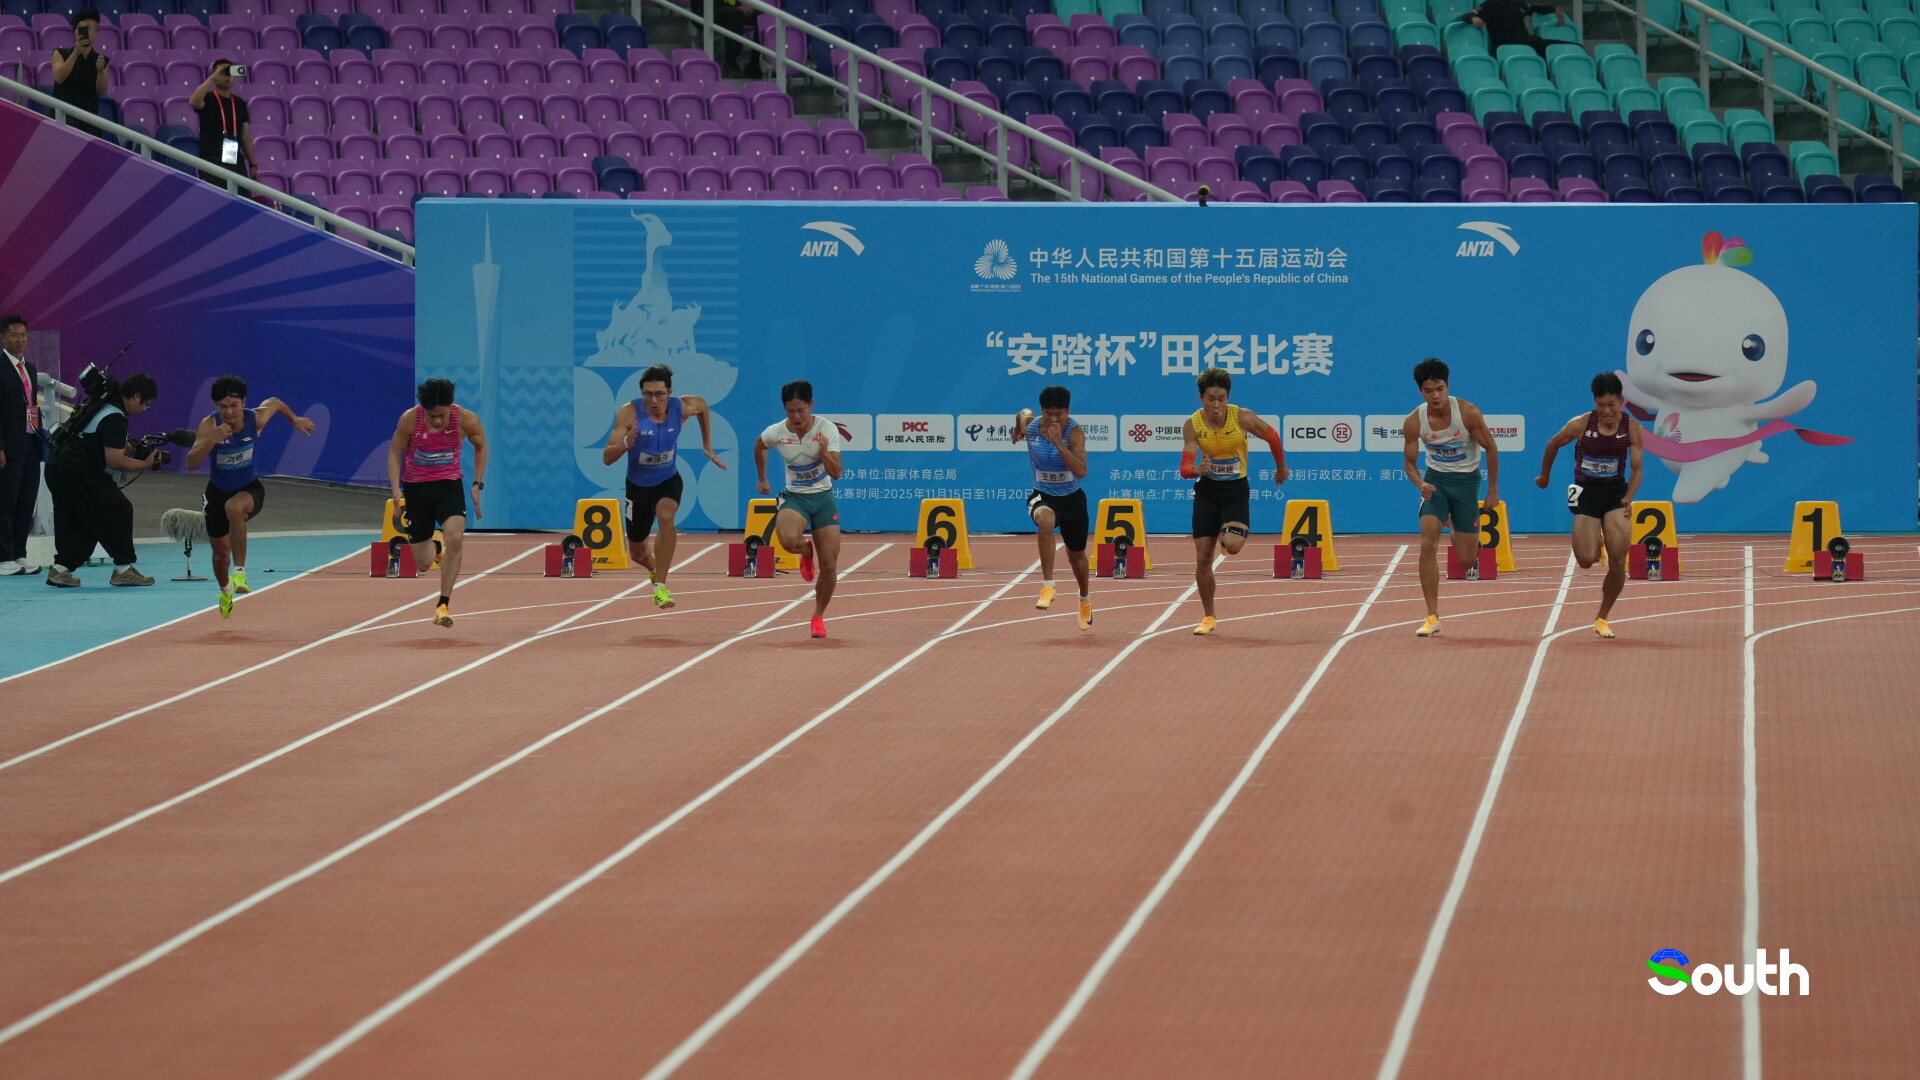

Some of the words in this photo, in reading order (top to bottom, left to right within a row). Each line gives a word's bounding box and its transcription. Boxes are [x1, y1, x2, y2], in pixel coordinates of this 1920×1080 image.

[800, 241, 839, 257] ANTA
[1029, 247, 1348, 269] 中华人民共和国第十五届运动会
[1455, 241, 1494, 257] ANTA
[1030, 273, 1050, 283] The
[1054, 273, 1078, 283] 15th
[1082, 273, 1127, 283] National
[1130, 273, 1168, 284] Games
[1171, 273, 1182, 283] of
[1185, 273, 1201, 283] the
[1205, 273, 1250, 285] People's
[1254, 273, 1300, 285] Republic
[1303, 273, 1315, 283] of
[1317, 273, 1348, 284] China
[902, 422, 928, 432] PICC
[1291, 427, 1327, 439] ICBC
[884, 435, 946, 443] 中国人民保险
[1568, 487, 1578, 505] 2
[582, 505, 613, 549] 8
[754, 505, 778, 547] 7
[927, 505, 958, 549] 6
[1104, 505, 1136, 542] 5
[1291, 506, 1323, 547] 4
[1635, 507, 1667, 545] 2
[1802, 507, 1823, 552] 1
